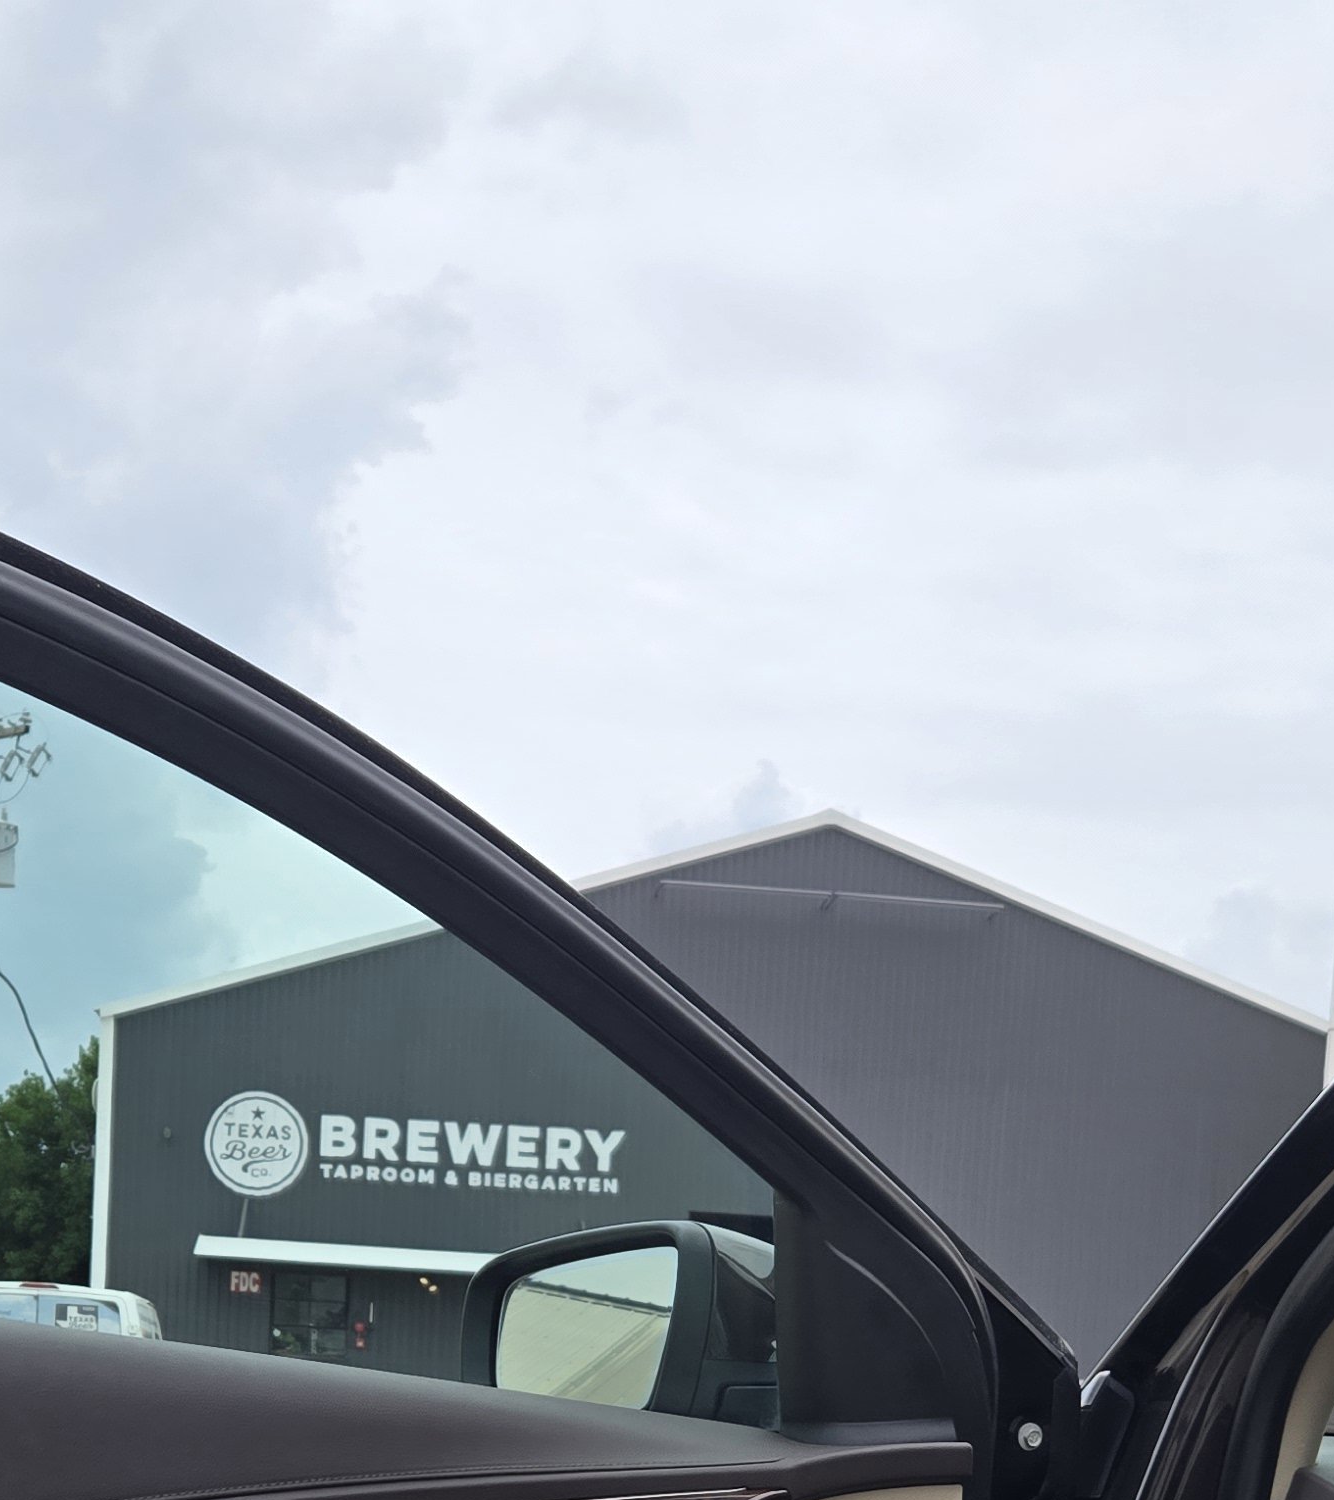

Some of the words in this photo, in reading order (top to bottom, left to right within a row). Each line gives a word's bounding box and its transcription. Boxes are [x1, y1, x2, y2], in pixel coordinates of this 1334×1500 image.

[224, 1122, 291, 1140] TEXAS
[220, 1140, 292, 1162] Beer
[320, 1114, 626, 1172] BREWERY
[319, 1163, 435, 1185] TAPROOM
[444, 1169, 459, 1186] &
[468, 1171, 619, 1194] BIERGARTEN
[230, 1270, 260, 1293] FDC
